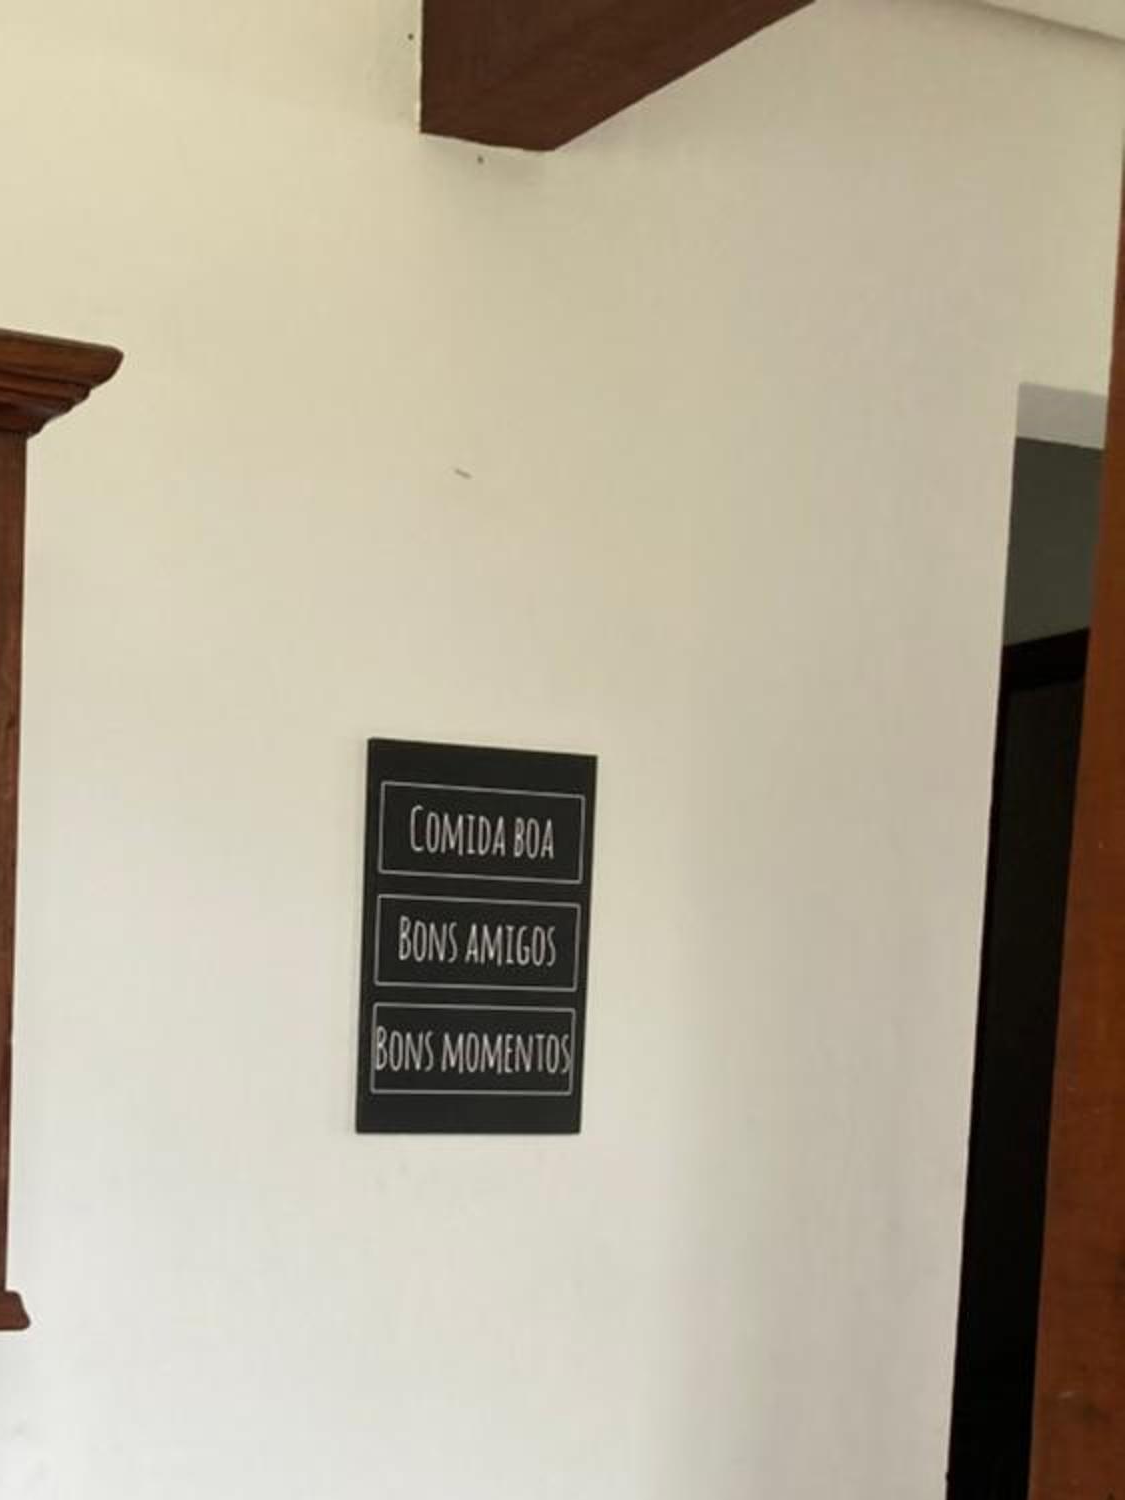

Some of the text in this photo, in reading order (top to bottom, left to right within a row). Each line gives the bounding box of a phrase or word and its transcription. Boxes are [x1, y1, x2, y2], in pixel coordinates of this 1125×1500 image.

[409, 805, 555, 859] COMIDA BOA
[398, 916, 556, 967] BONS AMIGOS
[375, 1026, 570, 1074] BONS MOMENTOS
